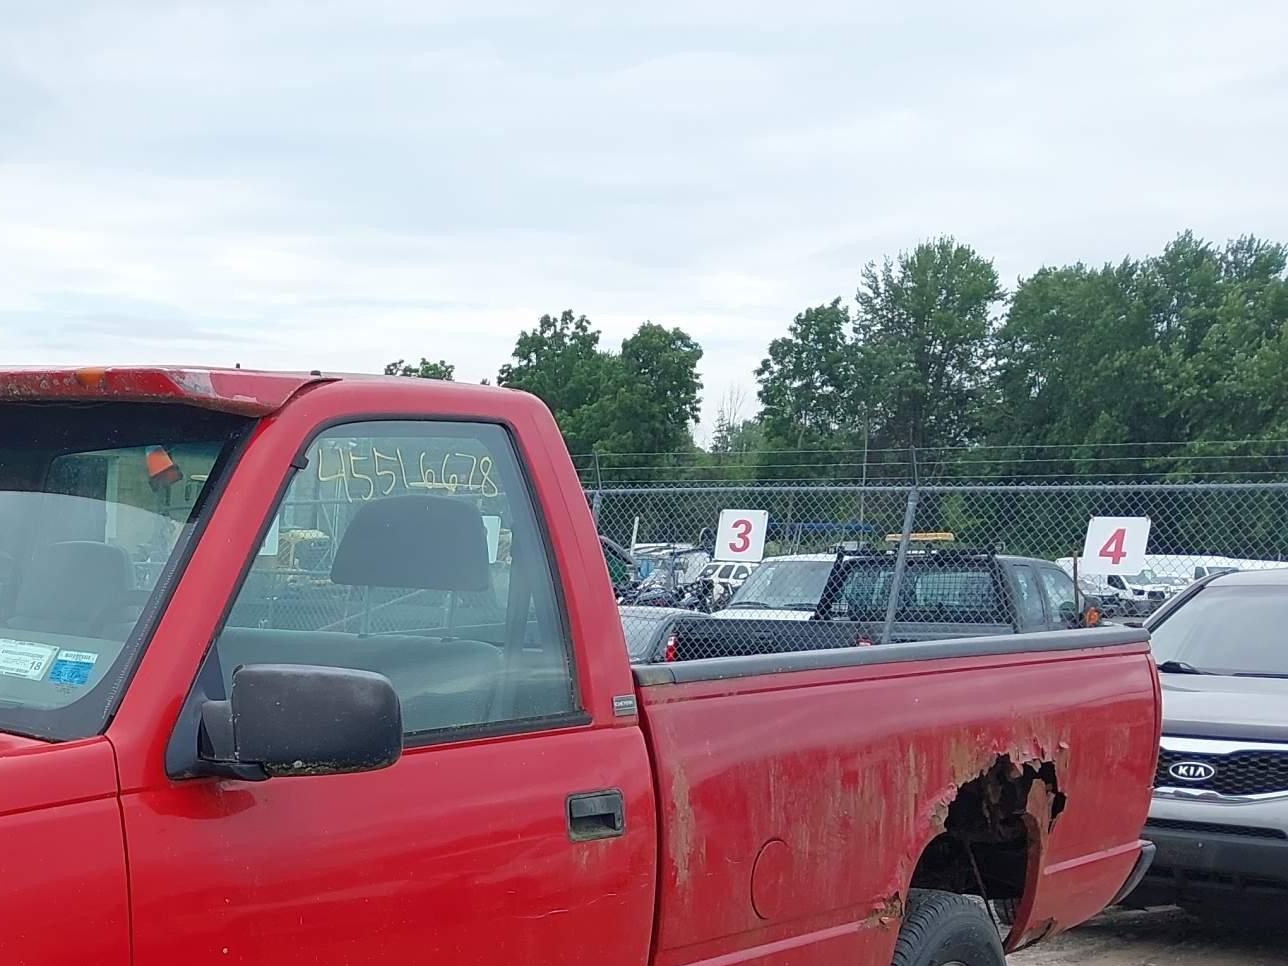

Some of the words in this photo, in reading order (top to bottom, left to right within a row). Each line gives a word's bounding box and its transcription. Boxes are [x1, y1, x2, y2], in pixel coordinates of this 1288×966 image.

[318, 447, 498, 503] 45516678
[728, 518, 753, 553] 3
[1098, 528, 1127, 565] 4
[29, 660, 43, 671] 18
[1178, 765, 1205, 777] KIA
